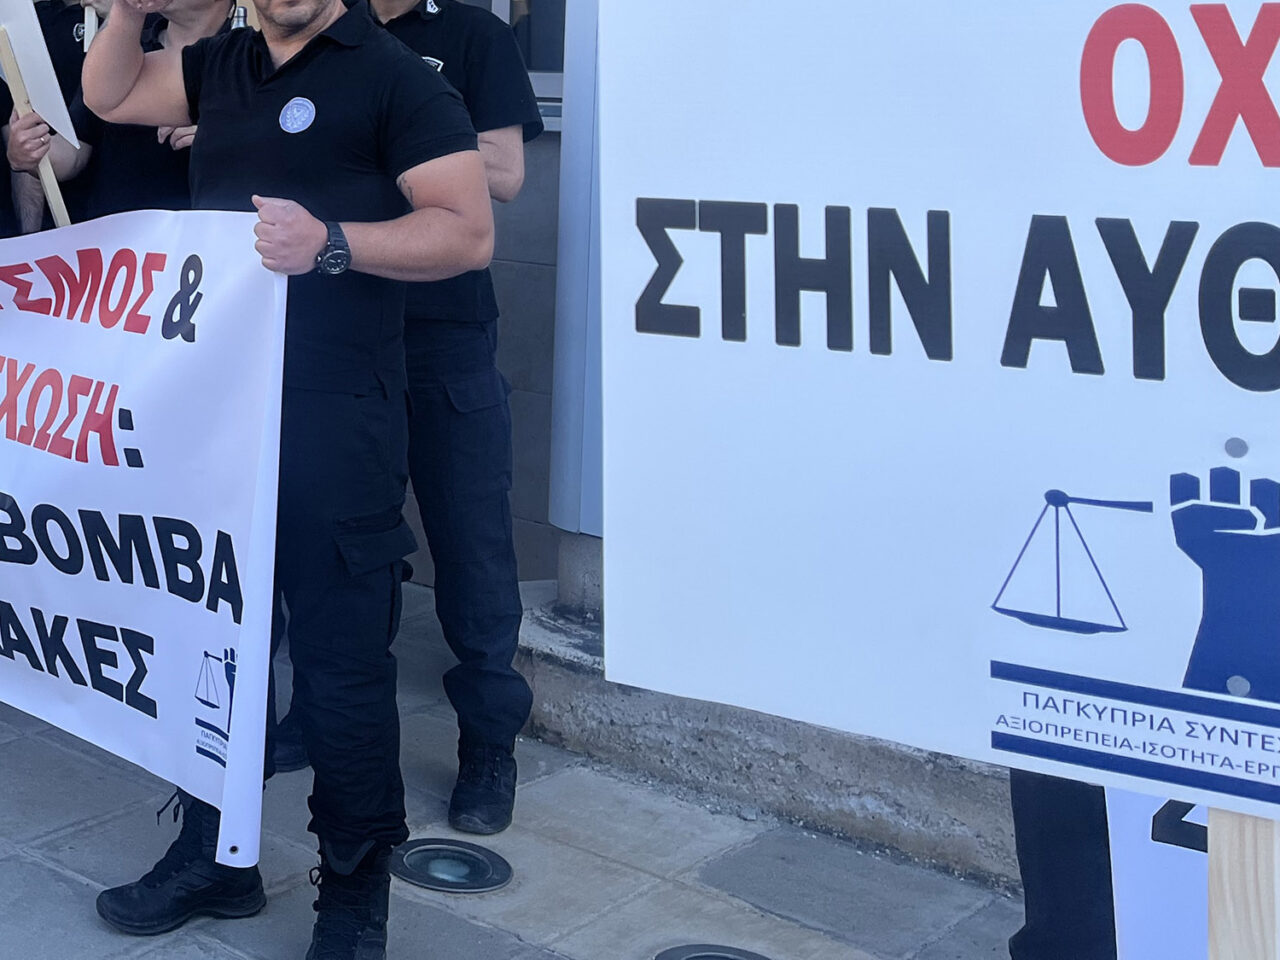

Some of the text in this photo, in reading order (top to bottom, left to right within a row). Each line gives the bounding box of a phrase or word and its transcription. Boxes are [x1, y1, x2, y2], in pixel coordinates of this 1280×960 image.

[162, 254, 203, 343] &
[635, 197, 1280, 393] ΣΤΗΝ ΑΥΘ
[1022, 691, 1280, 754] ΠΑΓΚΥΠΡΙΑ ΣΥΝΤΕ
